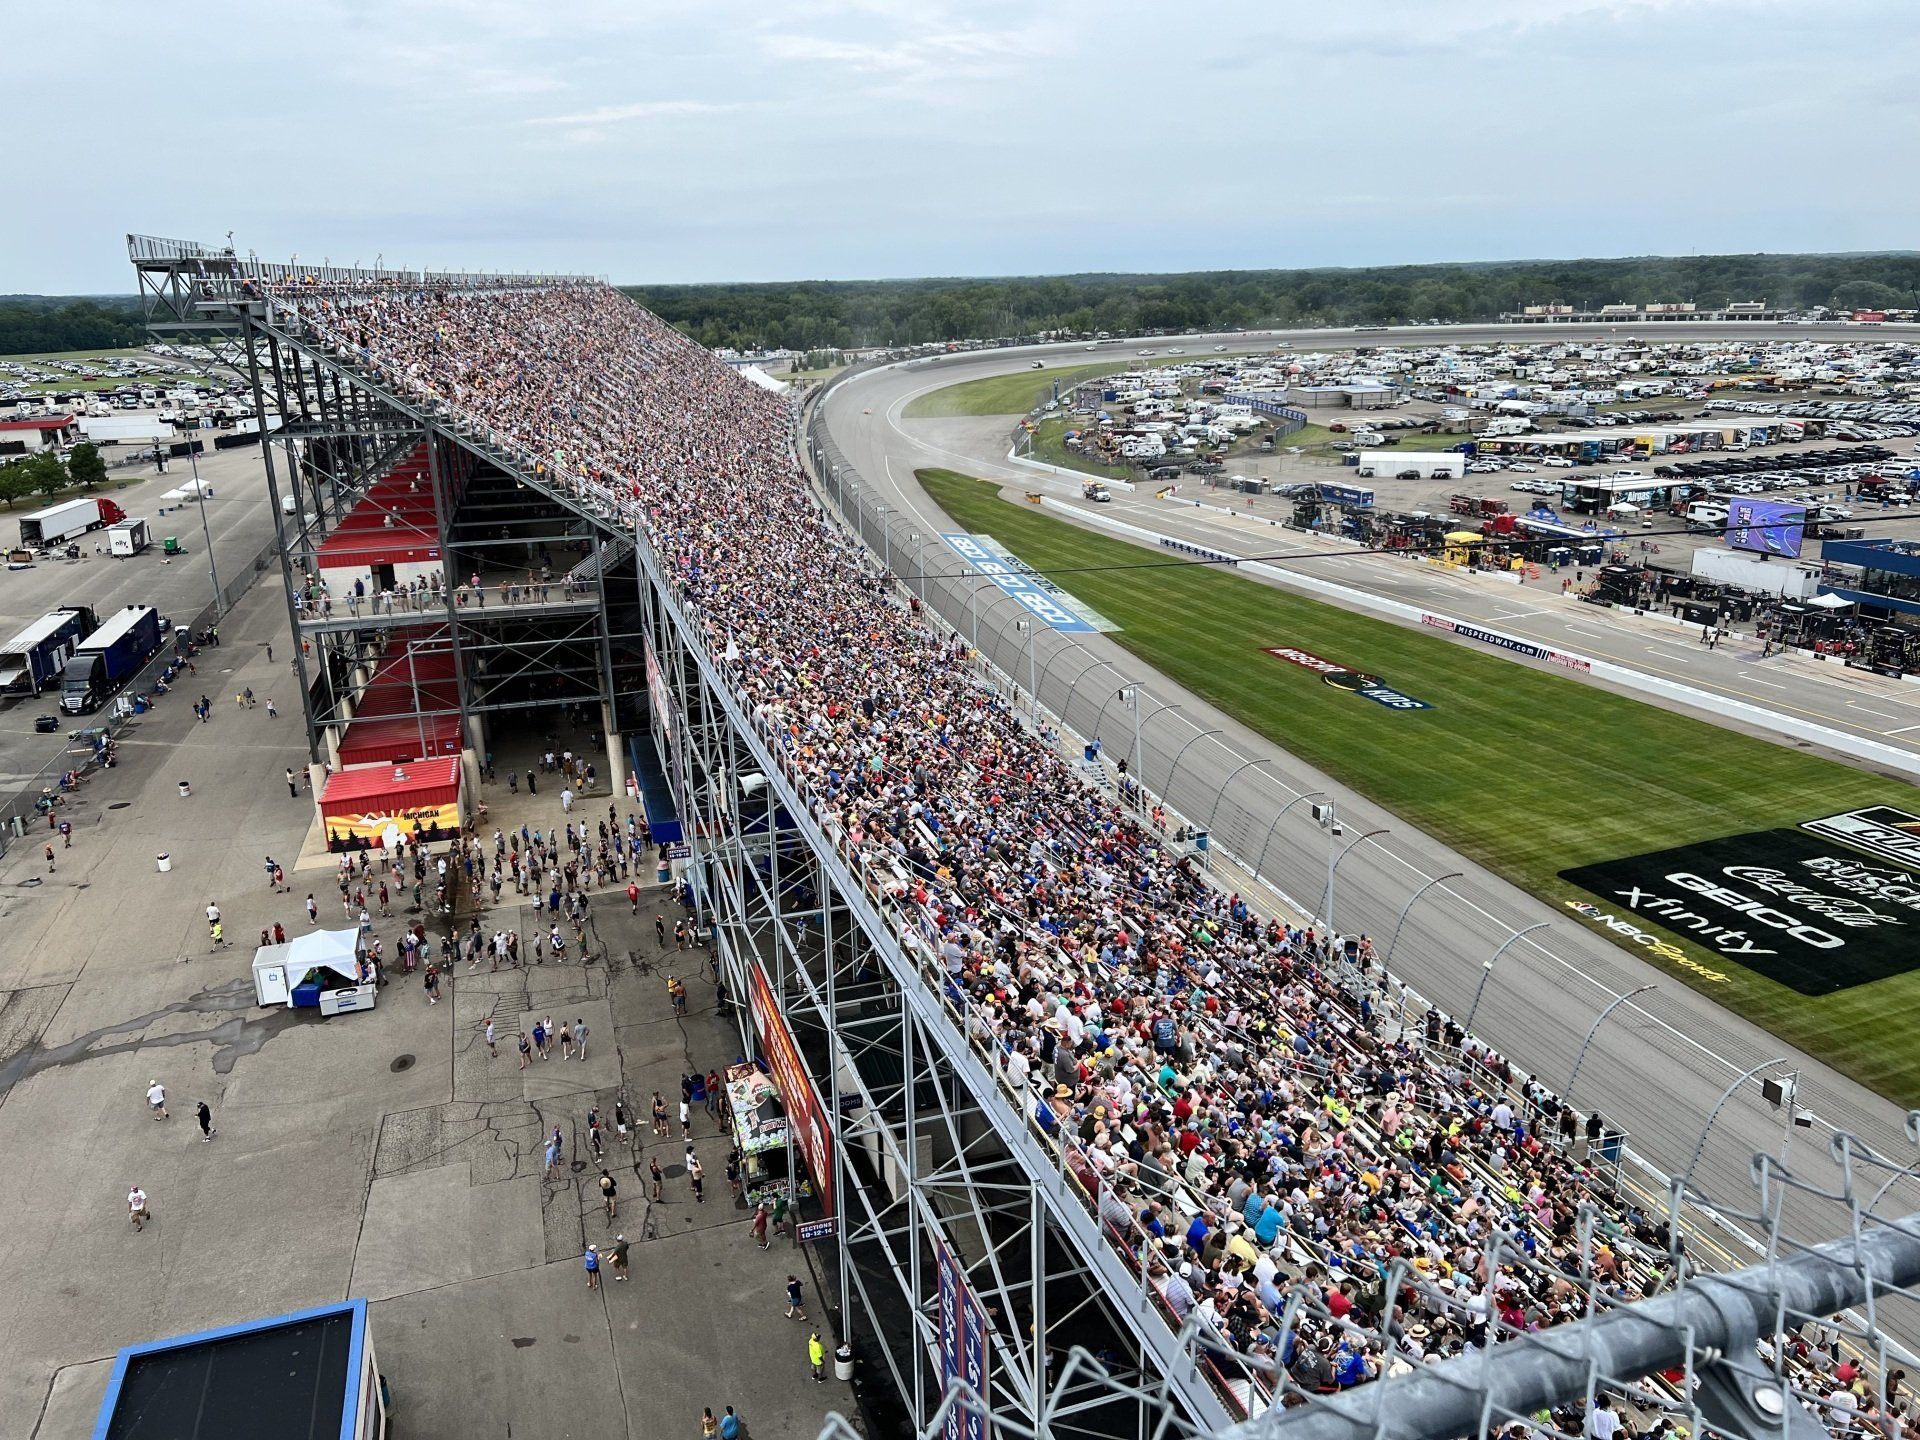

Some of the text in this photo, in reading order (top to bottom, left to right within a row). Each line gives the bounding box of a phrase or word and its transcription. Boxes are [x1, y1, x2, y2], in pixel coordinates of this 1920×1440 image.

[1627, 491, 1650, 502] Airgas
[947, 536, 989, 559] GEICO
[976, 562, 1028, 588] GEICO
[1014, 591, 1076, 624] GEICO
[1457, 627, 1535, 655] MISPEEDWAY.com
[1269, 648, 1347, 673] NASCAR
[1363, 688, 1424, 709] KIDS
[403, 809, 440, 821] MICHIGAN
[1811, 872, 1890, 902] LIGHT
[1613, 886, 1779, 955] xfinity
[1664, 872, 1846, 949] GEICO
[1595, 914, 1732, 983] NBC Sports
[800, 1221, 833, 1233] SECTIONS
[801, 1228, 833, 1239] 10-12-14
